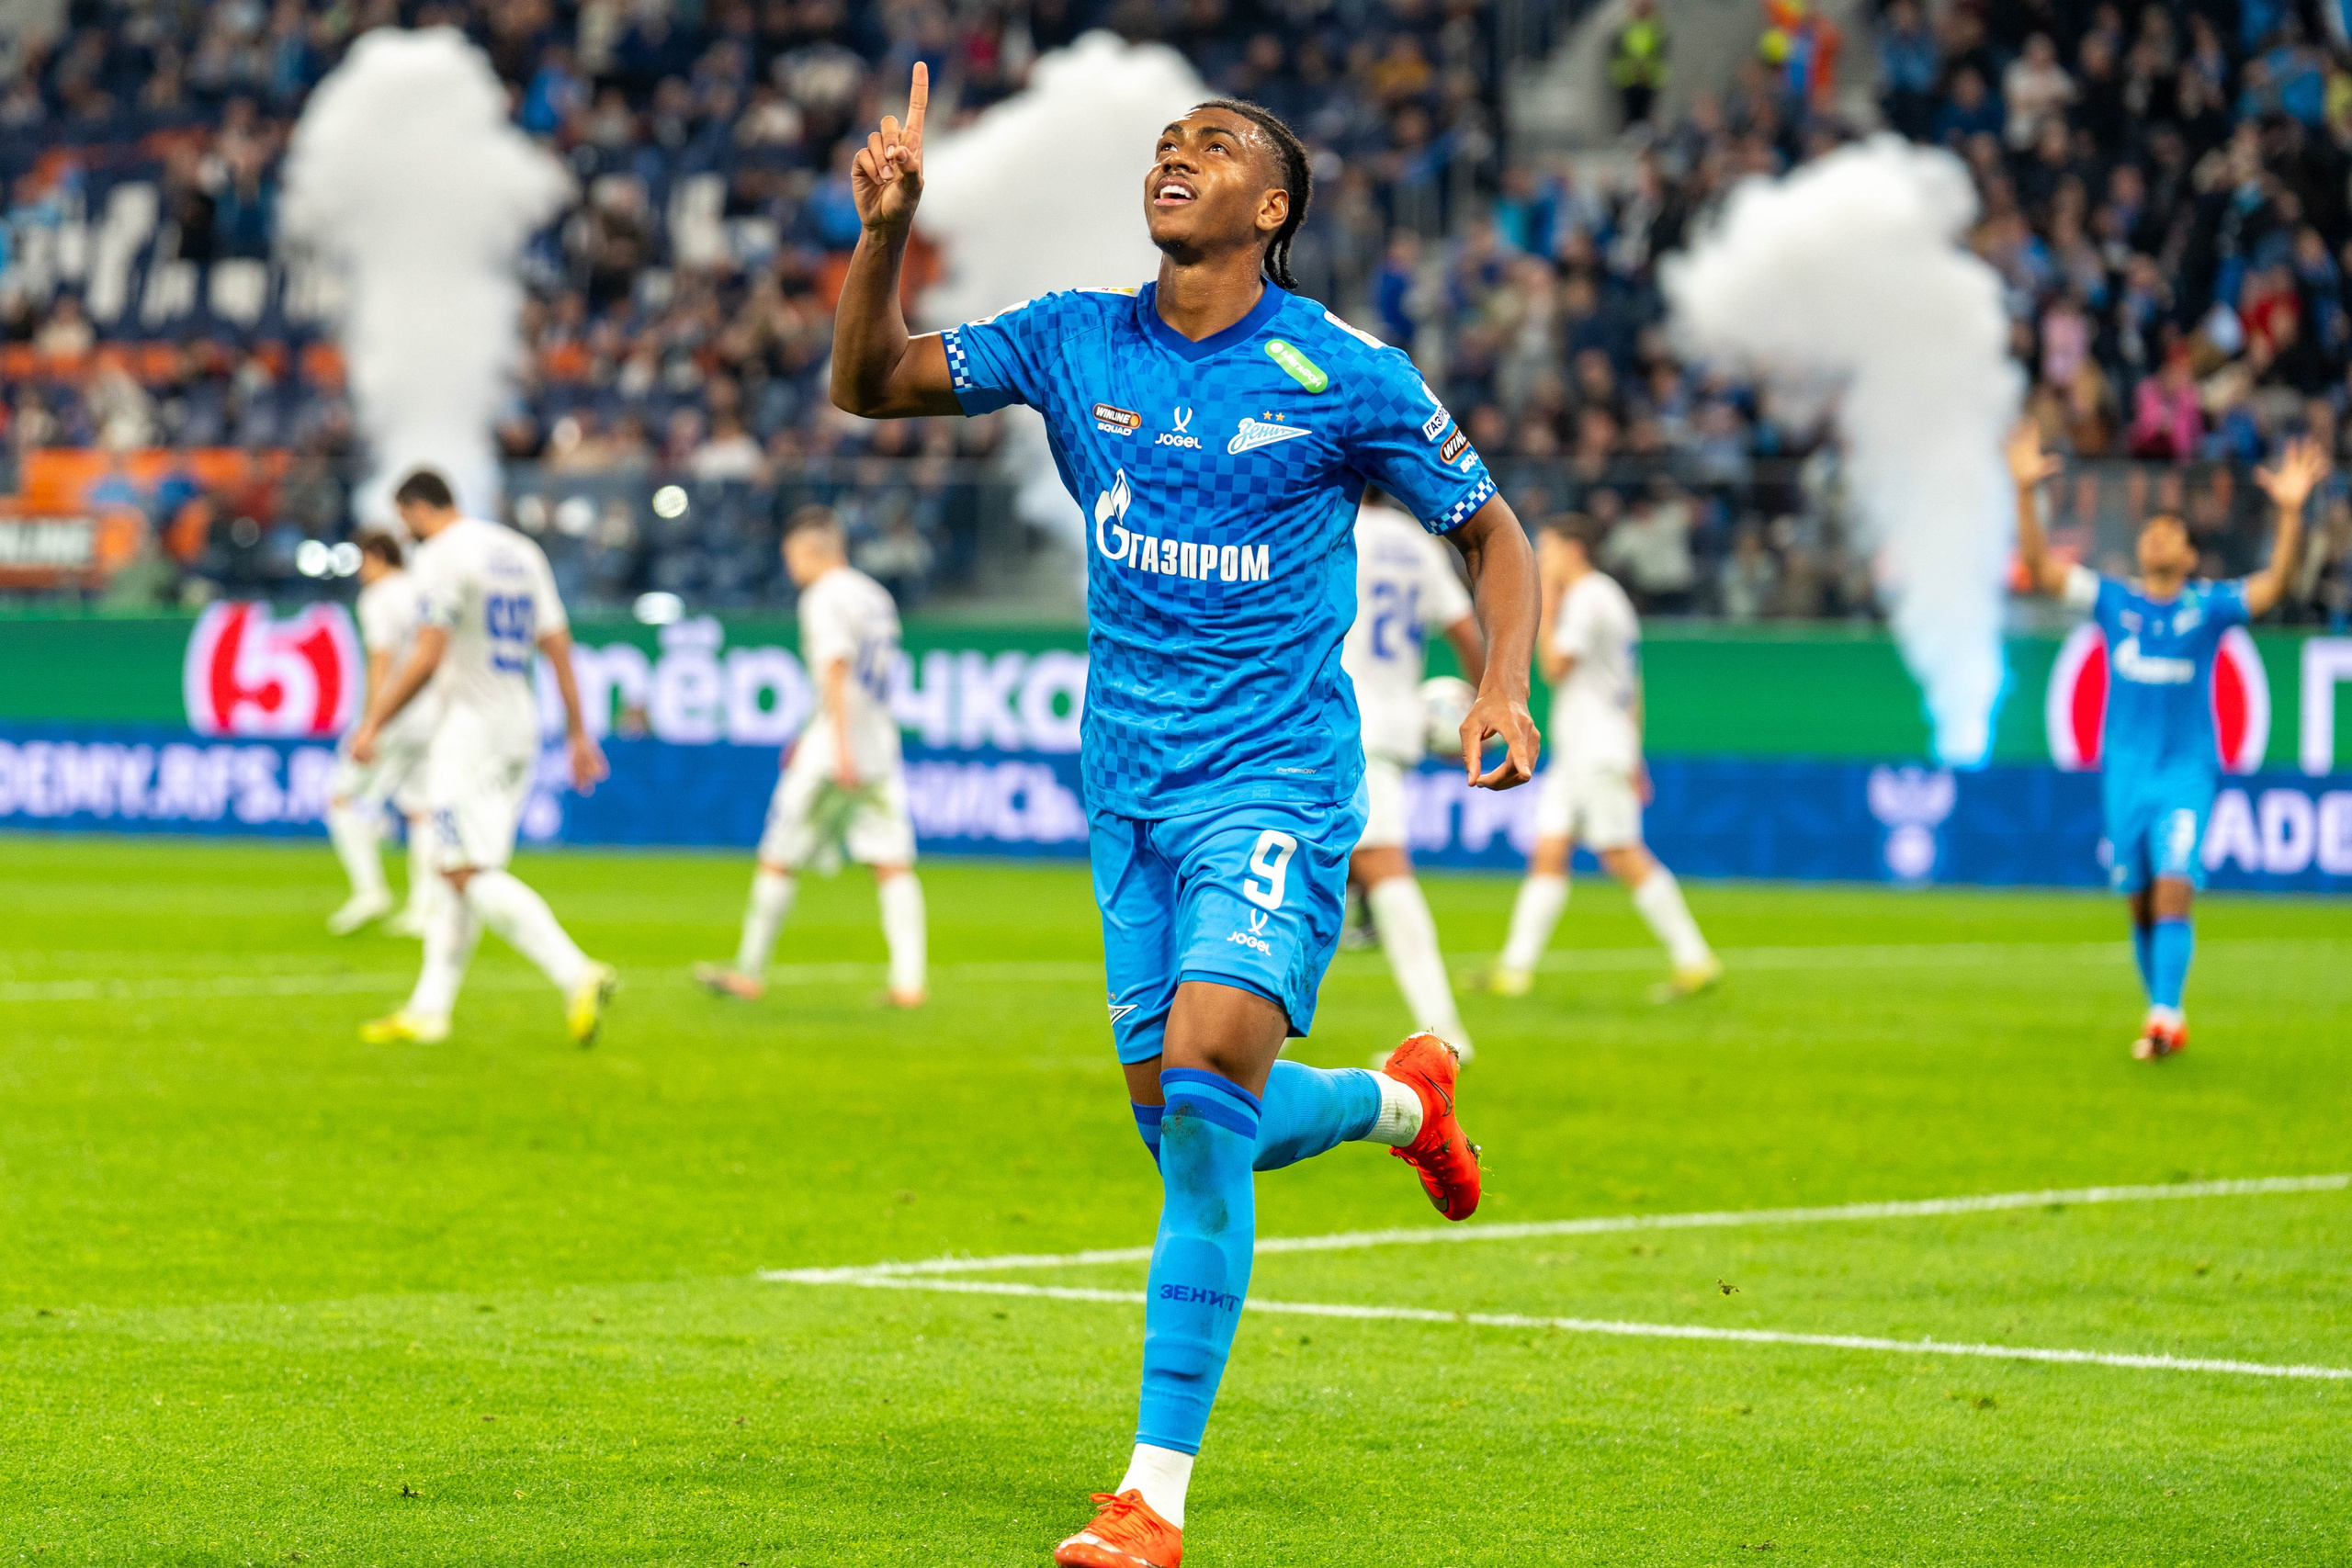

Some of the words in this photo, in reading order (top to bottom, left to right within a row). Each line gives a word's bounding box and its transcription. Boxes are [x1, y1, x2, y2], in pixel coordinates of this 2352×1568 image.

[1281, 350, 1322, 388] МЕГАФОН
[1096, 406, 1131, 424] WINLINE
[1097, 423, 1133, 436] SQUAD
[1128, 532, 1270, 581] ГАЗПРОМ
[1243, 829, 1297, 910] 9
[1159, 1283, 1240, 1312] ЗЕНИТ
